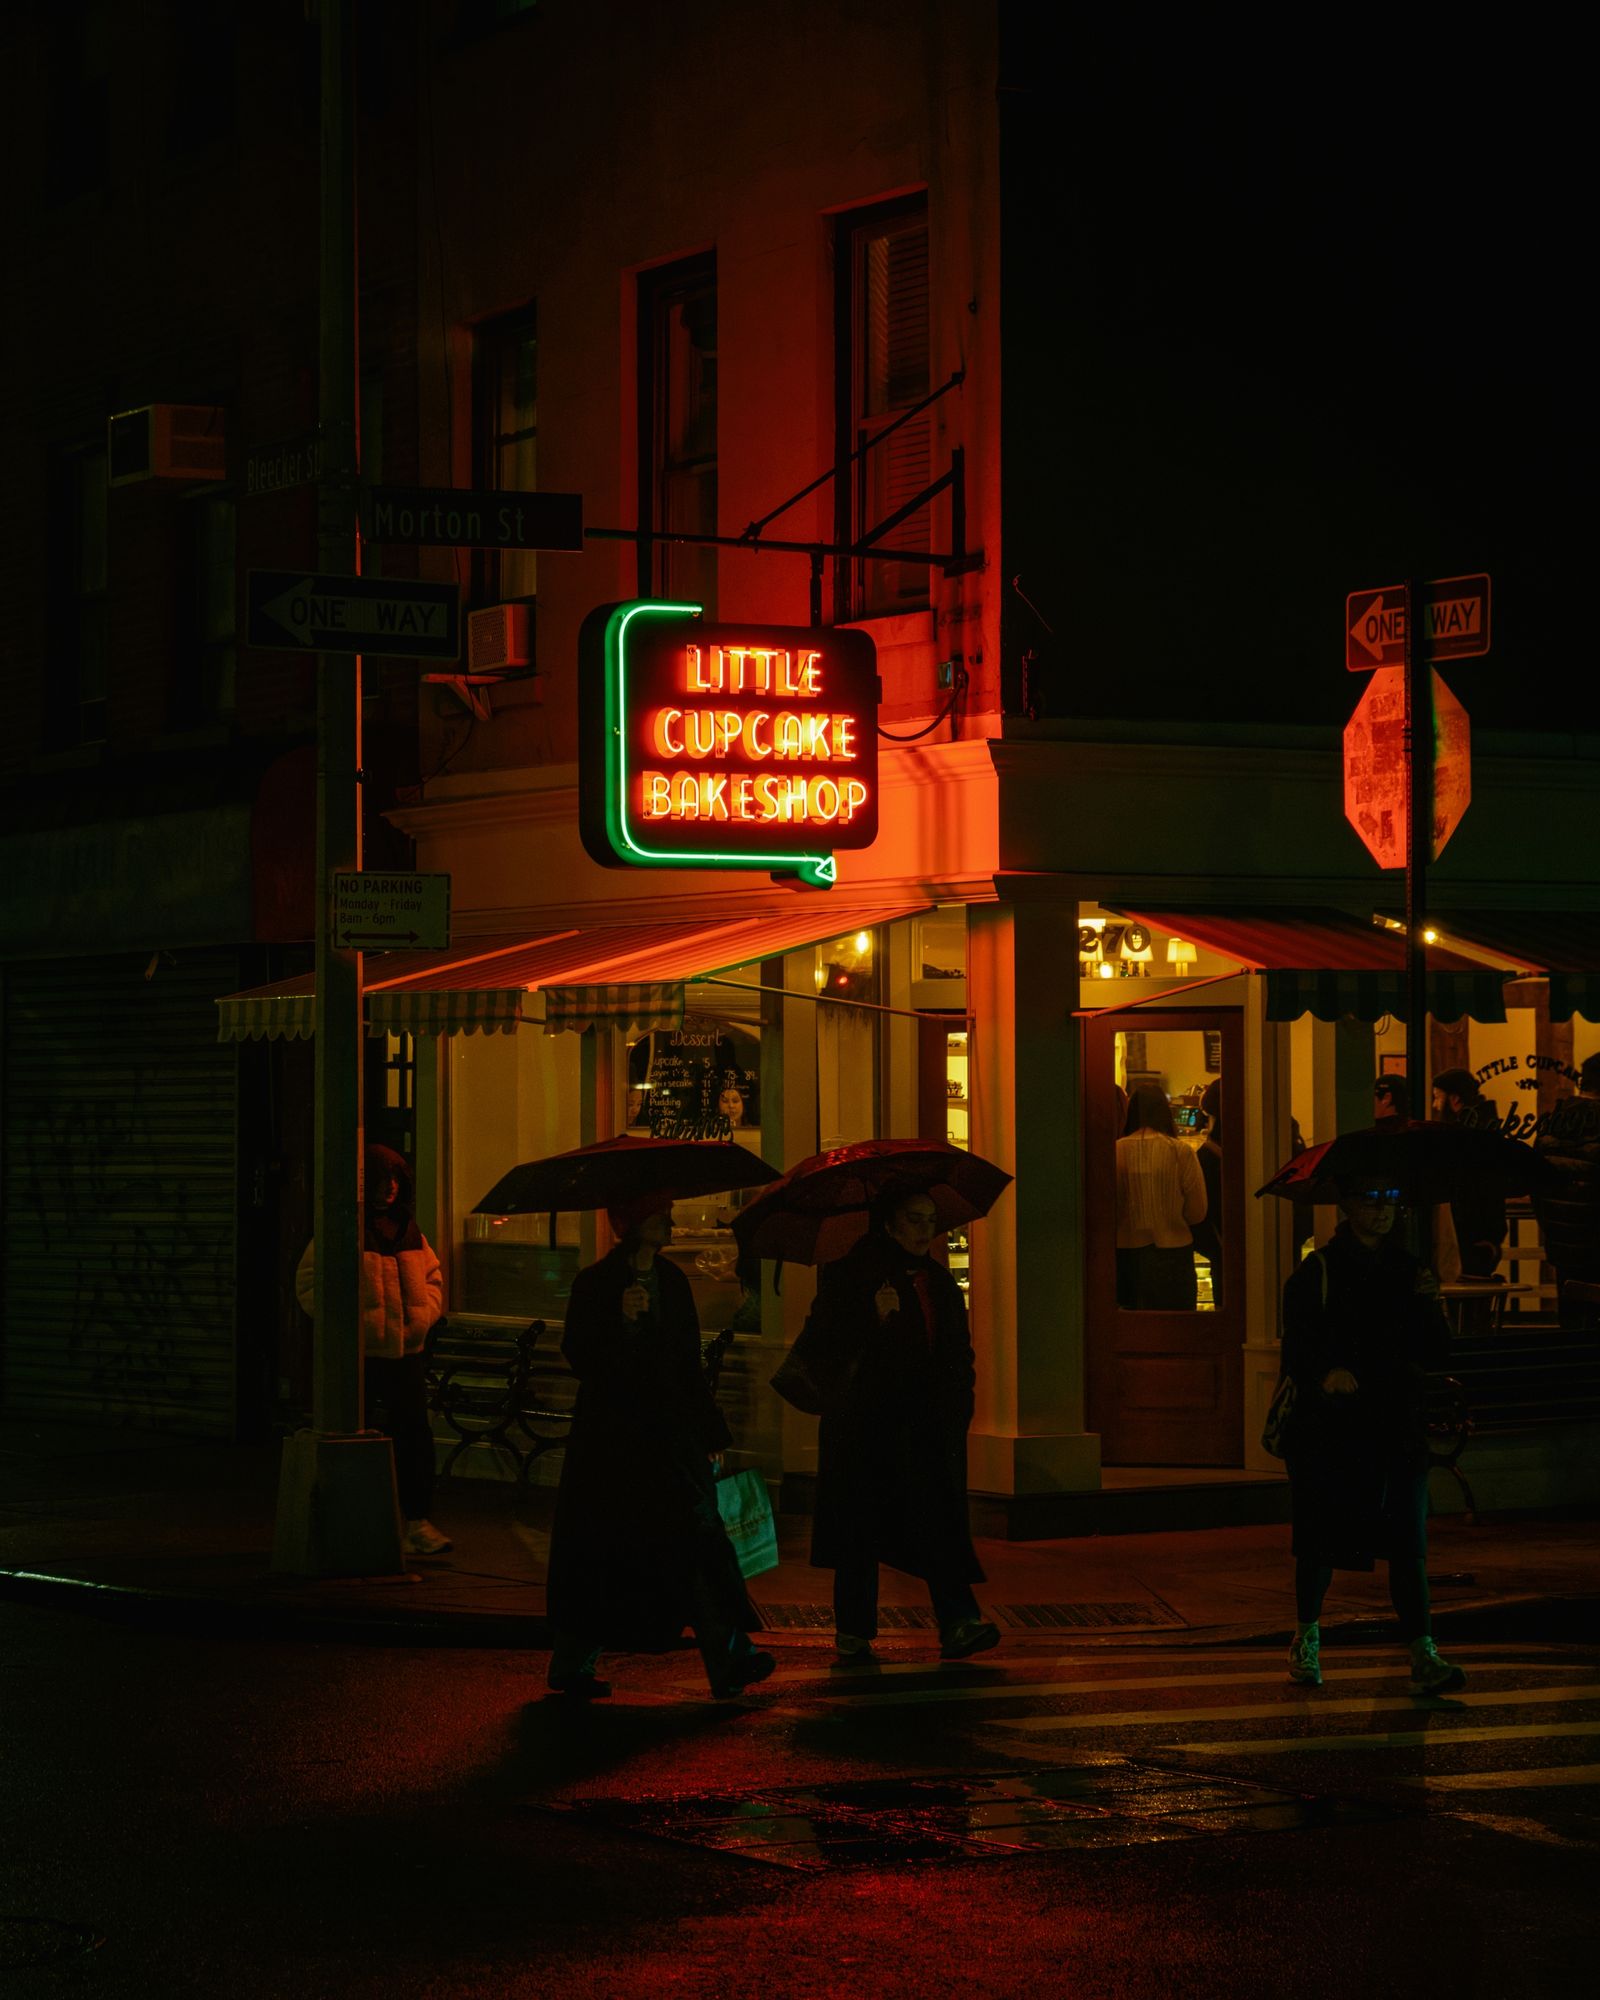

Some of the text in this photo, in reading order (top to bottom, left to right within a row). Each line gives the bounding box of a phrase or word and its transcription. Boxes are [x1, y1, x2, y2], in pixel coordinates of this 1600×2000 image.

[247, 443, 320, 491] Bleecker St
[375, 503, 527, 542] Morton St
[290, 597, 436, 634] ONE WAY
[1365, 600, 1476, 643] ONE WAY
[686, 644, 822, 697] LITTLE
[653, 706, 857, 762] CUPCAKE
[642, 771, 867, 825] BAKESHOP
[341, 880, 423, 894] NO PARKING
[340, 899, 379, 912] Monday
[390, 899, 423, 912] Friday
[340, 913, 362, 924] 8am
[372, 913, 396, 925] 6pm
[1079, 925, 1151, 954] 270
[670, 1028, 726, 1047] Dessert
[652, 1055, 684, 1070] upcake
[1474, 1056, 1518, 1087] ITTLE
[649, 1098, 681, 1108] Pudding
